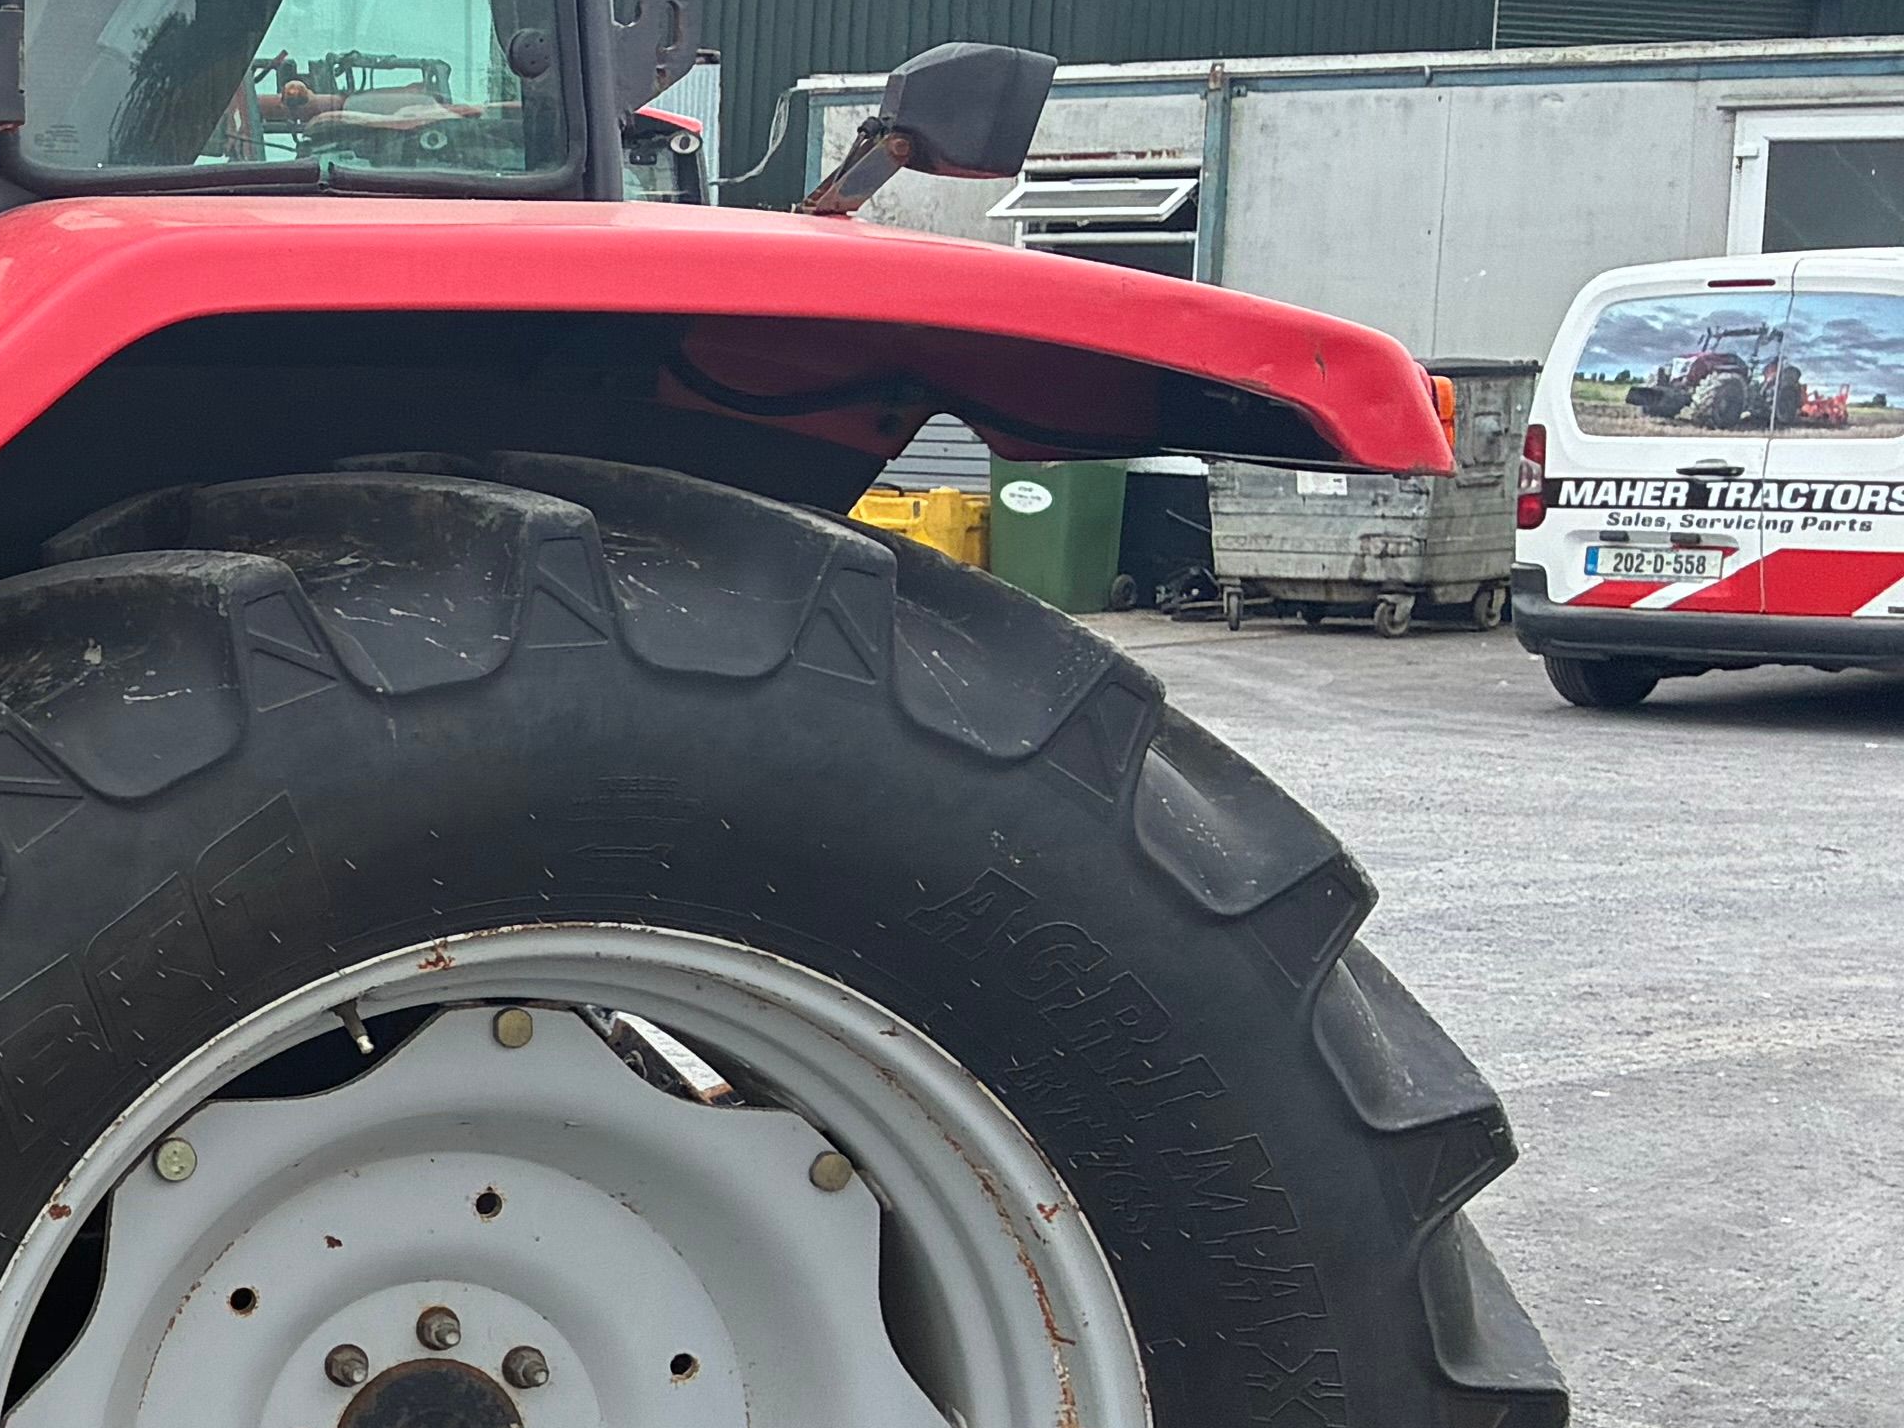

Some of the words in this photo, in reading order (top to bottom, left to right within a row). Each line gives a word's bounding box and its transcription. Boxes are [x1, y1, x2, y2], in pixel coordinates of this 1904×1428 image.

[1558, 480, 1691, 508] MAHER
[1706, 482, 1904, 513] TRACTORS
[1606, 511, 1673, 531] Sales,
[1679, 513, 1794, 534] Servicing
[1800, 516, 1873, 532] Parts
[1612, 551, 1707, 575] 202-D-558
